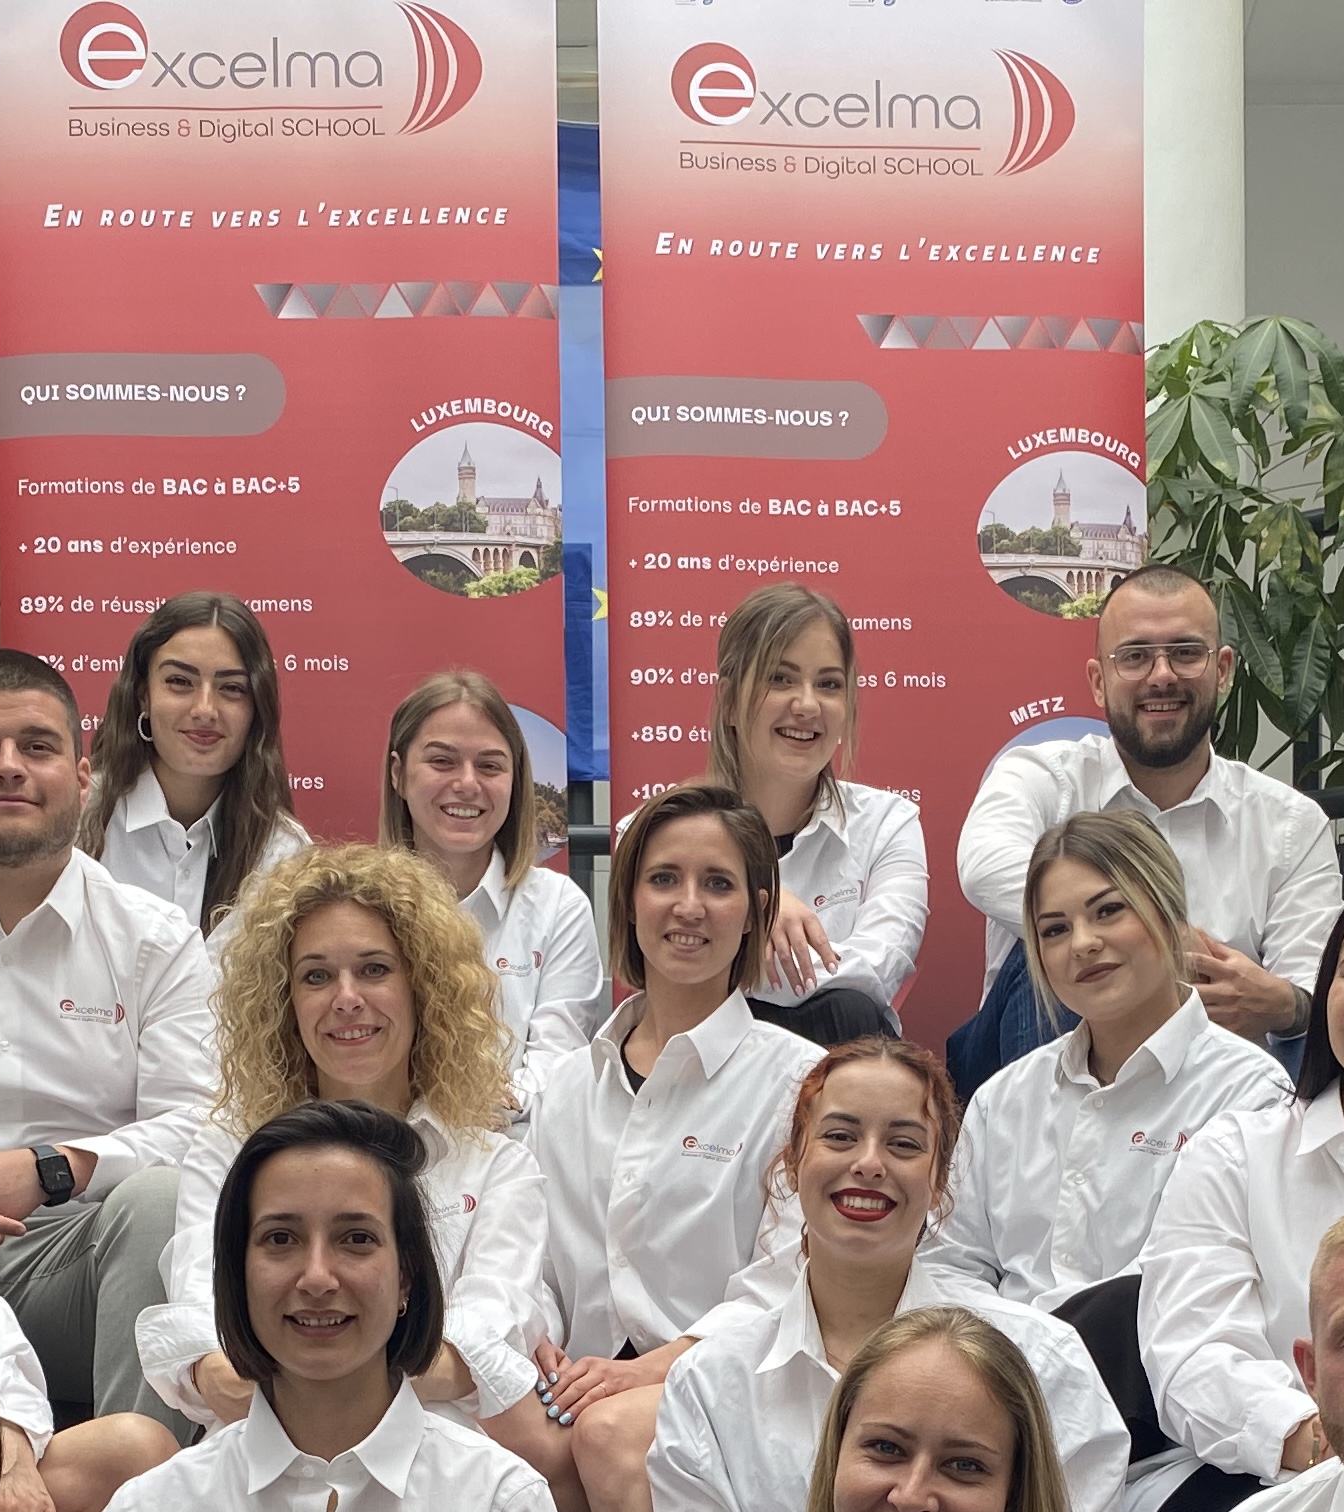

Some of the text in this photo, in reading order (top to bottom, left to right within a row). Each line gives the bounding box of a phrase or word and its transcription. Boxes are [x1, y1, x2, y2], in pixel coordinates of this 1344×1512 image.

[59, 1, 383, 91] excelma
[670, 41, 982, 131] excelma
[68, 116, 386, 143] Business & Digital SCHOOL
[679, 151, 983, 180] Business & Digital SCHOOL
[100, 208, 194, 228] ROUTE
[211, 207, 282, 228] VERS
[709, 237, 800, 260] ROUTE
[816, 240, 883, 261] VERS
[19, 383, 248, 406] QUI SOMMES-NOUS ?
[409, 397, 555, 440] LUXEMBOURG
[631, 405, 850, 428] QUI SOMMES-NOUS ?
[1006, 426, 1142, 470] LUXEMBOURG
[17, 475, 302, 497] Formations de BAC à BAC+5
[627, 496, 902, 517] Formations de BAC à BAC+5
[18, 536, 238, 558] + 20 ans d'expérience
[628, 553, 840, 577] + 20 ans d'expérience
[19, 595, 65, 614] 89%
[70, 595, 95, 613] de
[629, 610, 675, 628] 89%
[679, 610, 703, 627] de
[284, 654, 298, 672] 6
[304, 653, 350, 672] mois
[630, 667, 675, 685] 90%
[884, 670, 897, 688] 6
[903, 671, 947, 688] mois
[1009, 696, 1066, 727] METZ
[630, 725, 683, 743] +850
